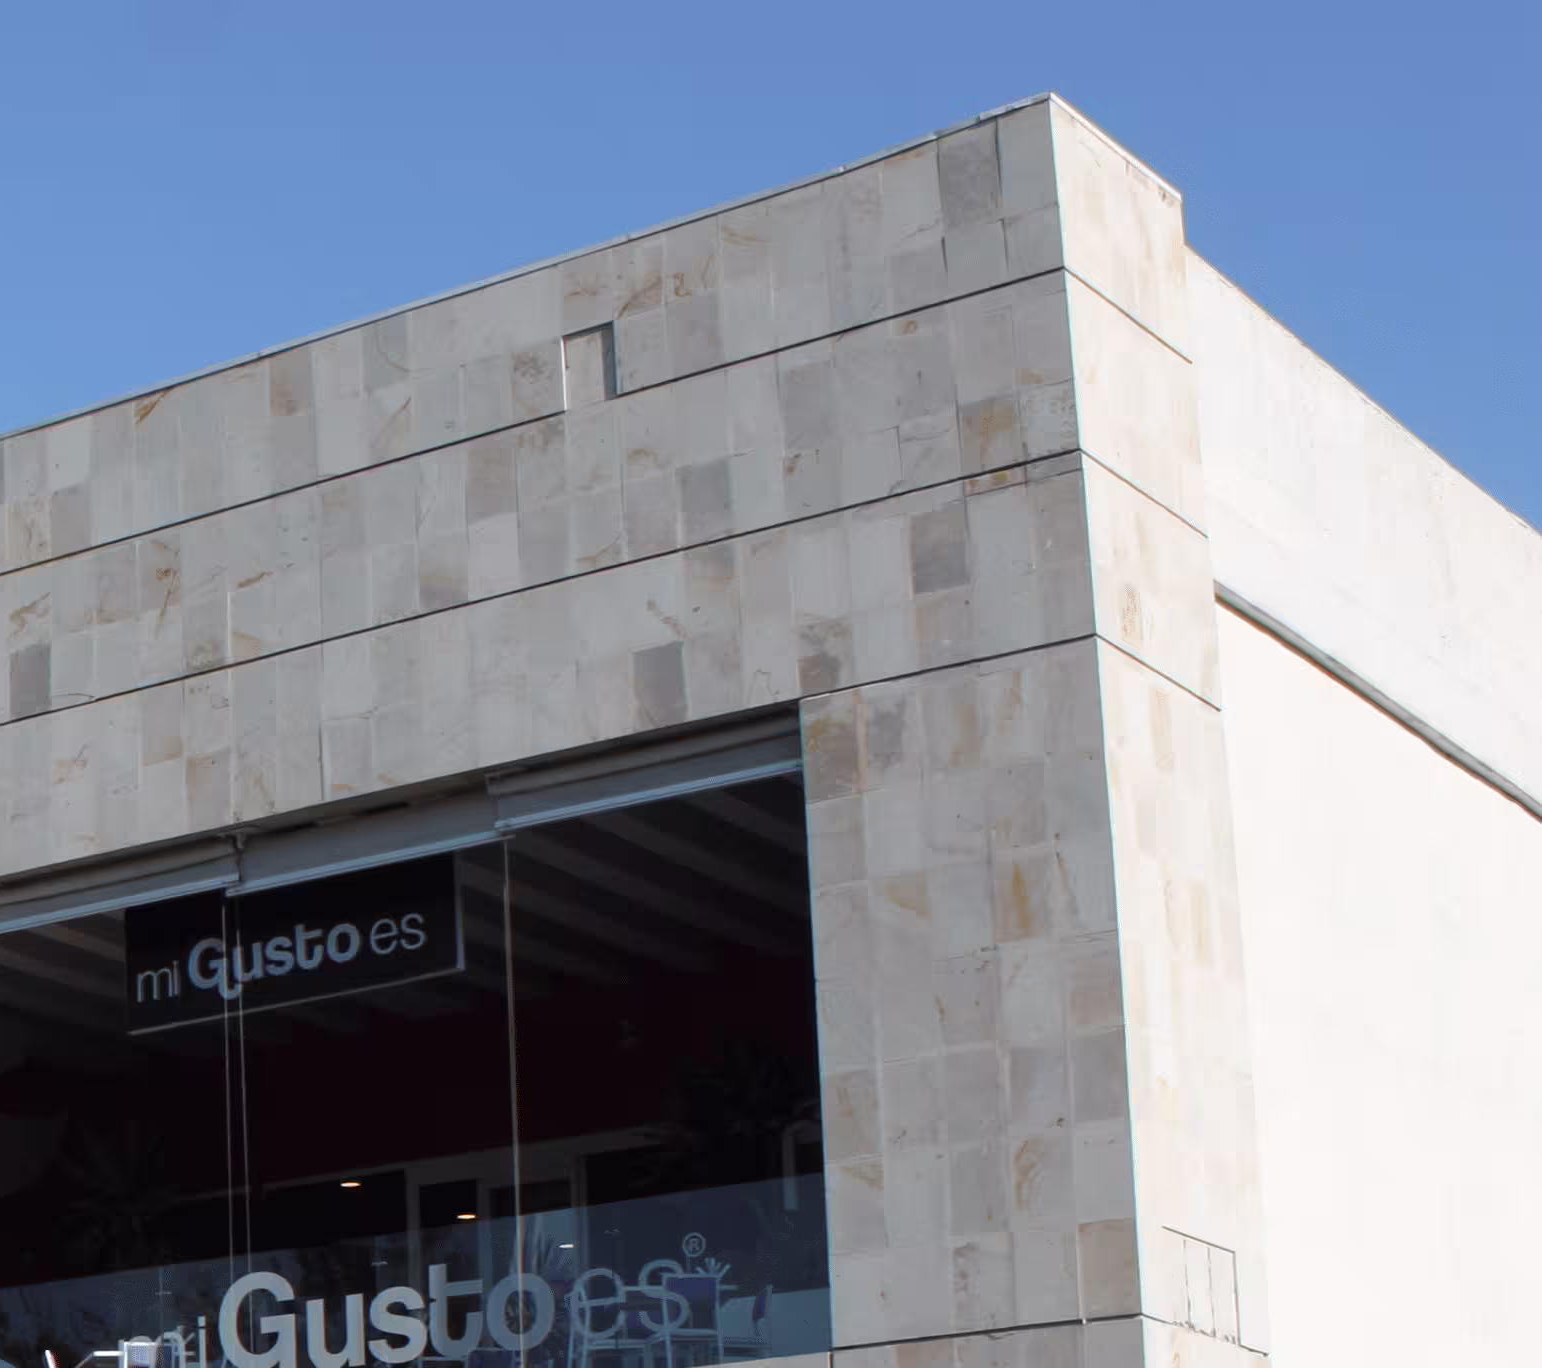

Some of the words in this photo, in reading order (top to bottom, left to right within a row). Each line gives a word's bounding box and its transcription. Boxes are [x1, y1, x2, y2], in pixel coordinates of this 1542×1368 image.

[137, 960, 181, 1003] mi
[188, 923, 360, 1000] Gusto
[370, 913, 427, 955] es
